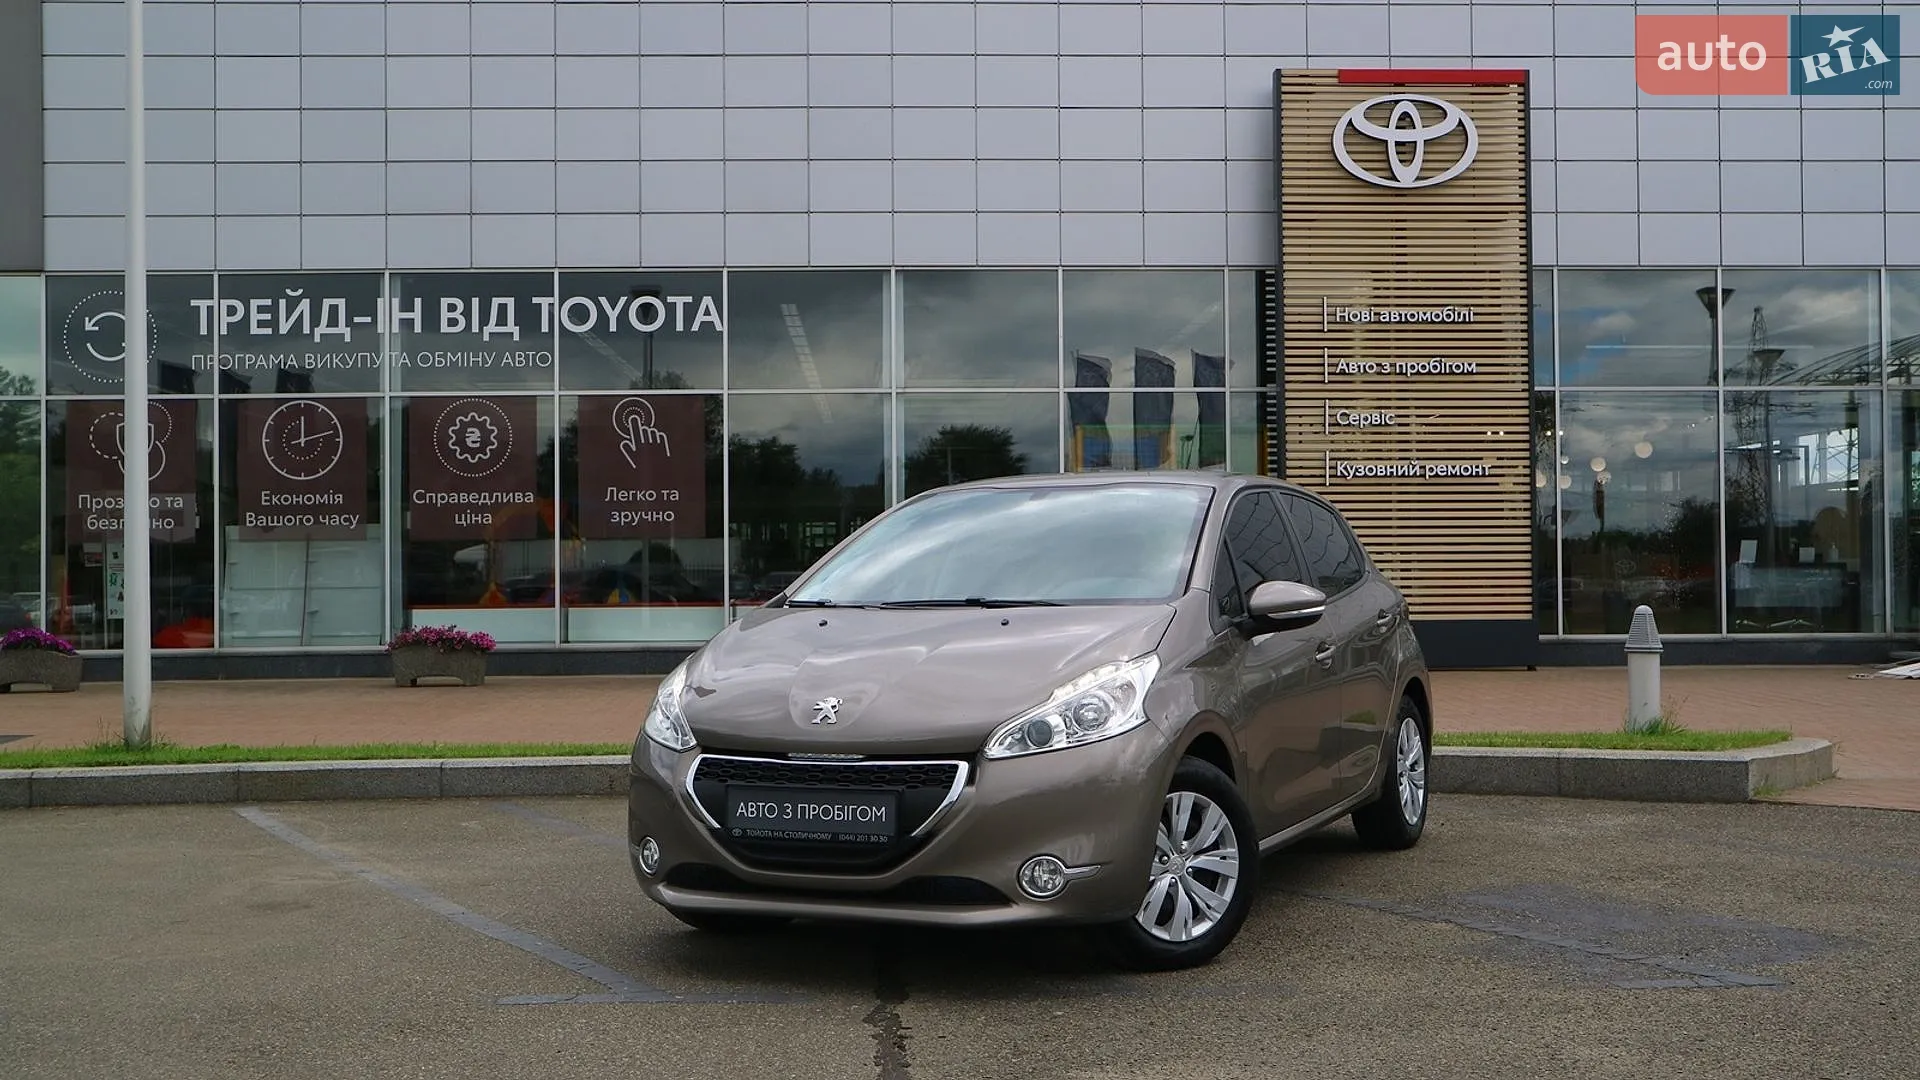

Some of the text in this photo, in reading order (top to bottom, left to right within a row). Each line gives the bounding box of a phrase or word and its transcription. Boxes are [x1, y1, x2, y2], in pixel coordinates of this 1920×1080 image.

[190, 288, 724, 342] ТРЕЙД-ІН ВІД TOYOTA
[1335, 306, 1475, 323] Нові автомобілі
[192, 350, 552, 370] ПРОГРАМА ВИКУПУ ТА ОБМІНУ АВТО
[1335, 358, 1477, 377] Авто з пробігом
[1336, 409, 1396, 429] Сервіс
[1336, 459, 1492, 480] Кузовний ремонт
[78, 494, 184, 511] Прозо та
[261, 490, 343, 505] Економія
[413, 489, 535, 507] Справедлива
[605, 487, 680, 501] Легко та
[87, 514, 175, 530] безно
[246, 512, 360, 529] Вашого часу
[455, 510, 493, 525] ціна
[610, 510, 675, 525] зручно
[736, 802, 886, 822] АВТО З ПРОБІГОМ
